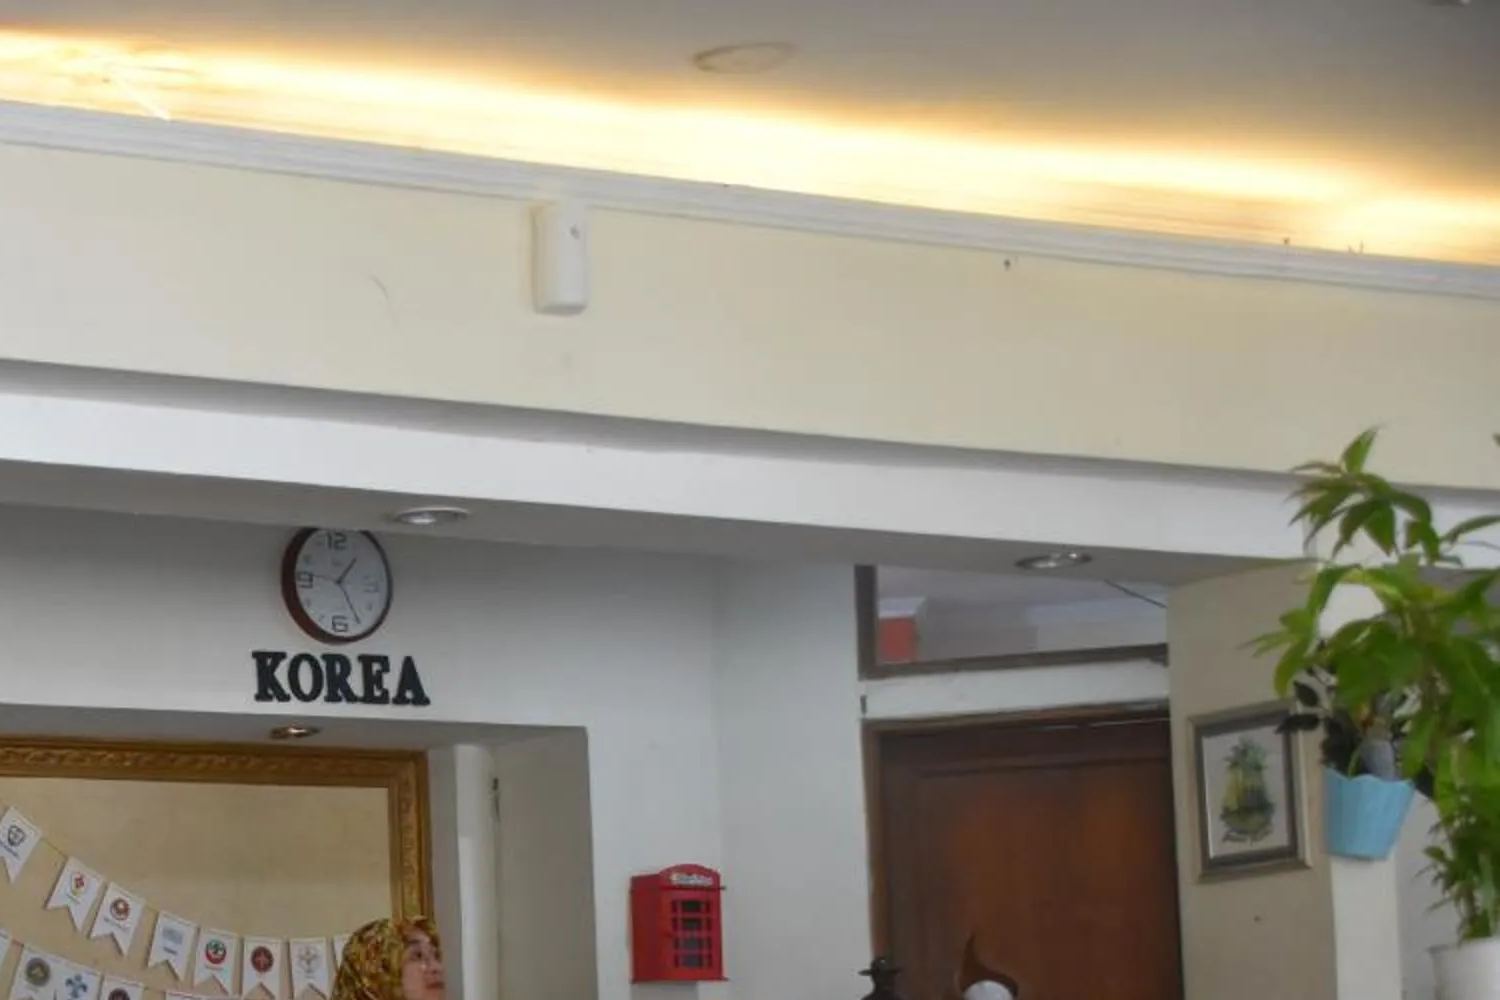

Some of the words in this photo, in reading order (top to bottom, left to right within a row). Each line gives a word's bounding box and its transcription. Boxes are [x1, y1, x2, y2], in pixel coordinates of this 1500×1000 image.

[326, 532, 348, 550] 12
[297, 570, 314, 589] 9
[331, 615, 349, 633] 6
[252, 651, 431, 706] KOREA
